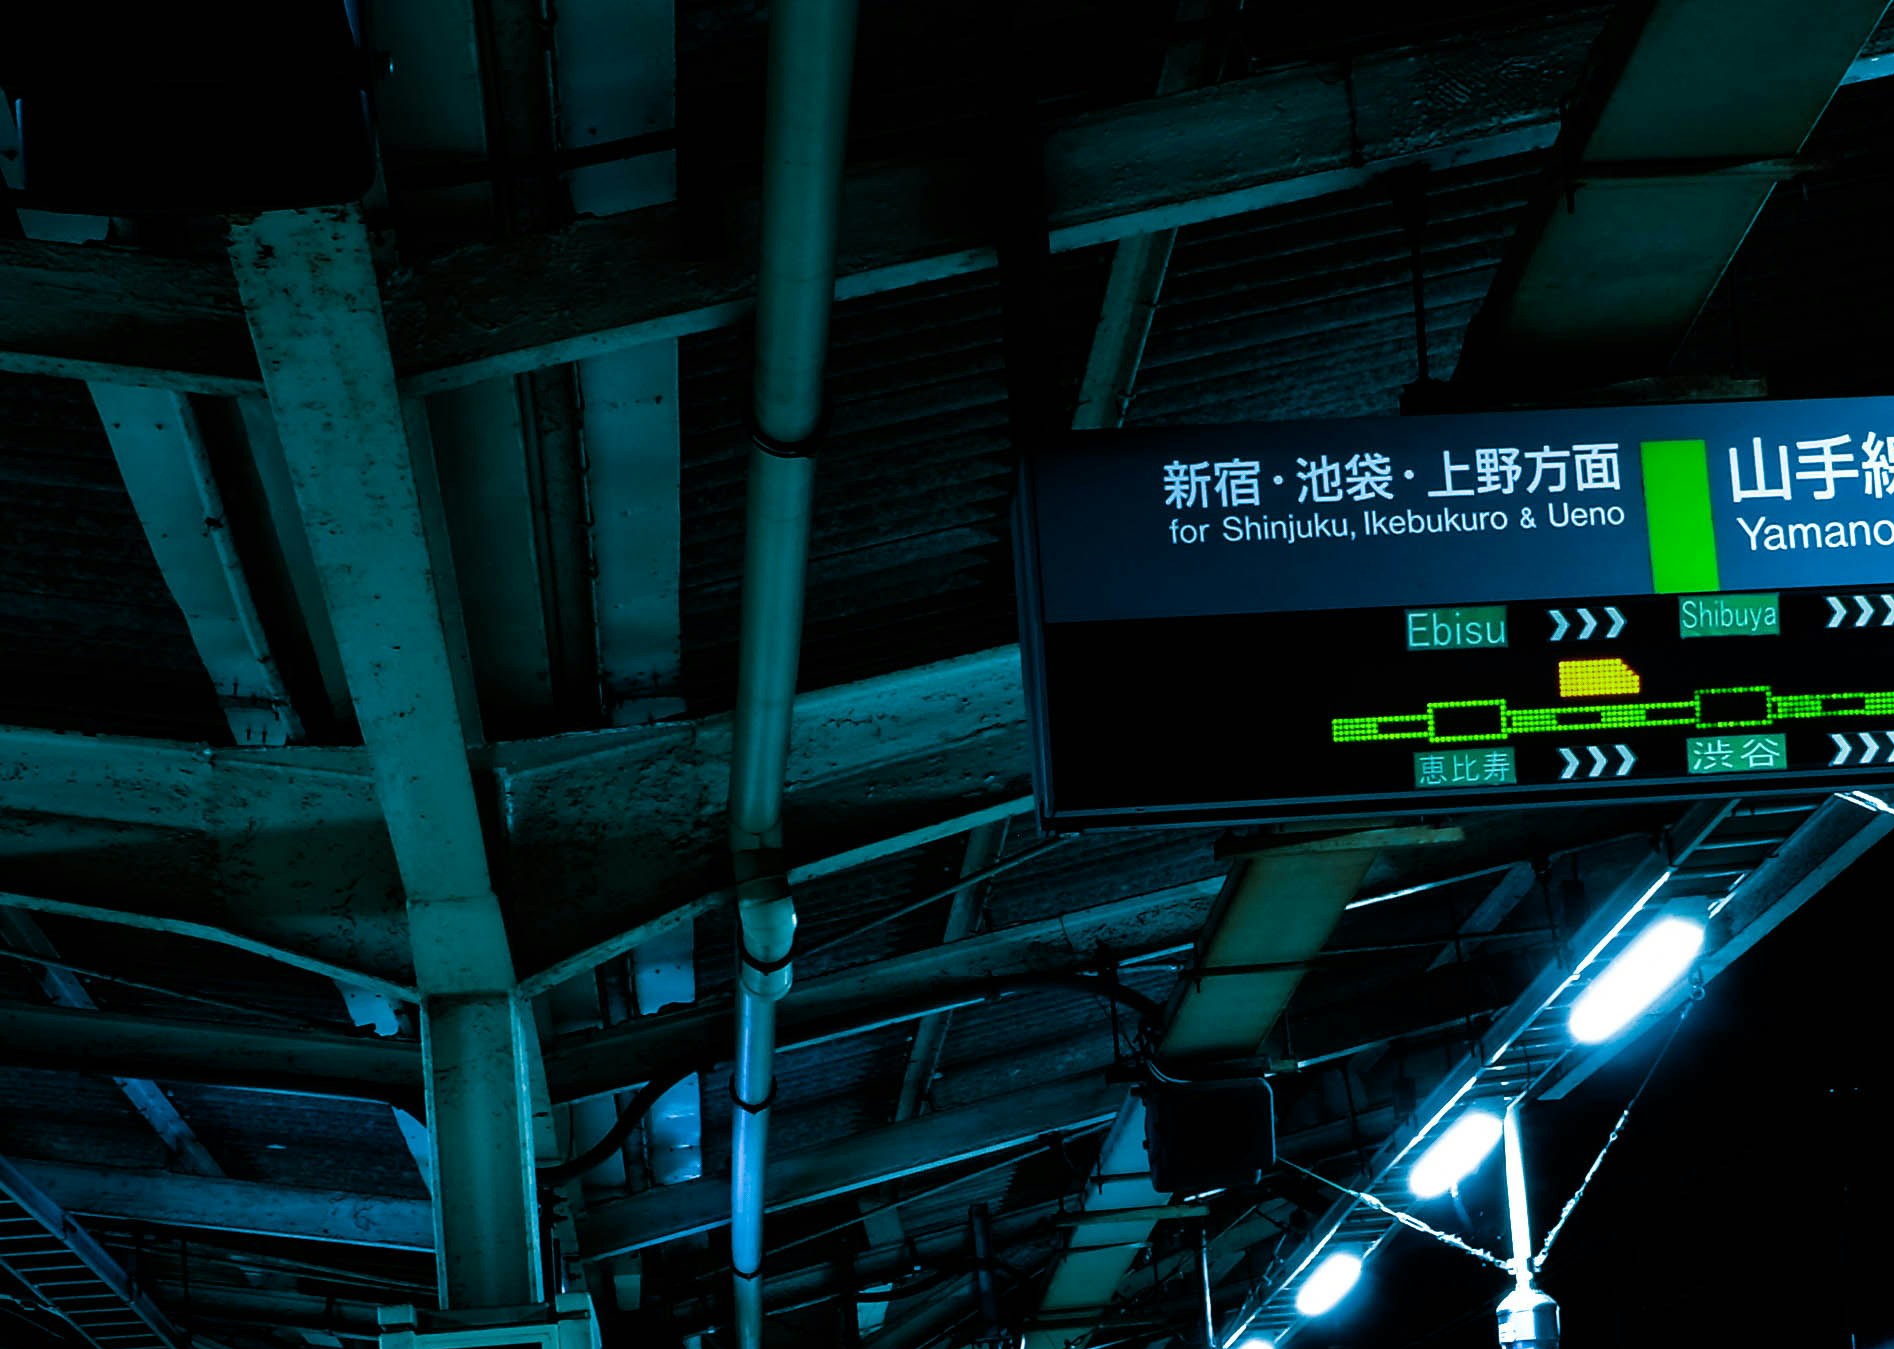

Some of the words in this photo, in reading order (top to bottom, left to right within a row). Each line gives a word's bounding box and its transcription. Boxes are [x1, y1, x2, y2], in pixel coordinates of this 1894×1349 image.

[1164, 442, 1622, 509] 新宿・池袋・上野方面
[1169, 519, 1209, 544] for
[1222, 512, 1356, 542] Shinjuku,
[1364, 508, 1508, 538] Ikebukuro
[1520, 507, 1536, 529] &
[1547, 503, 1625, 529] Ueno
[1409, 613, 1506, 647] Ebisu
[1682, 599, 1777, 633] Shibuya
[1419, 752, 1511, 784] 恵比寿
[1692, 738, 1783, 771] 渋谷
